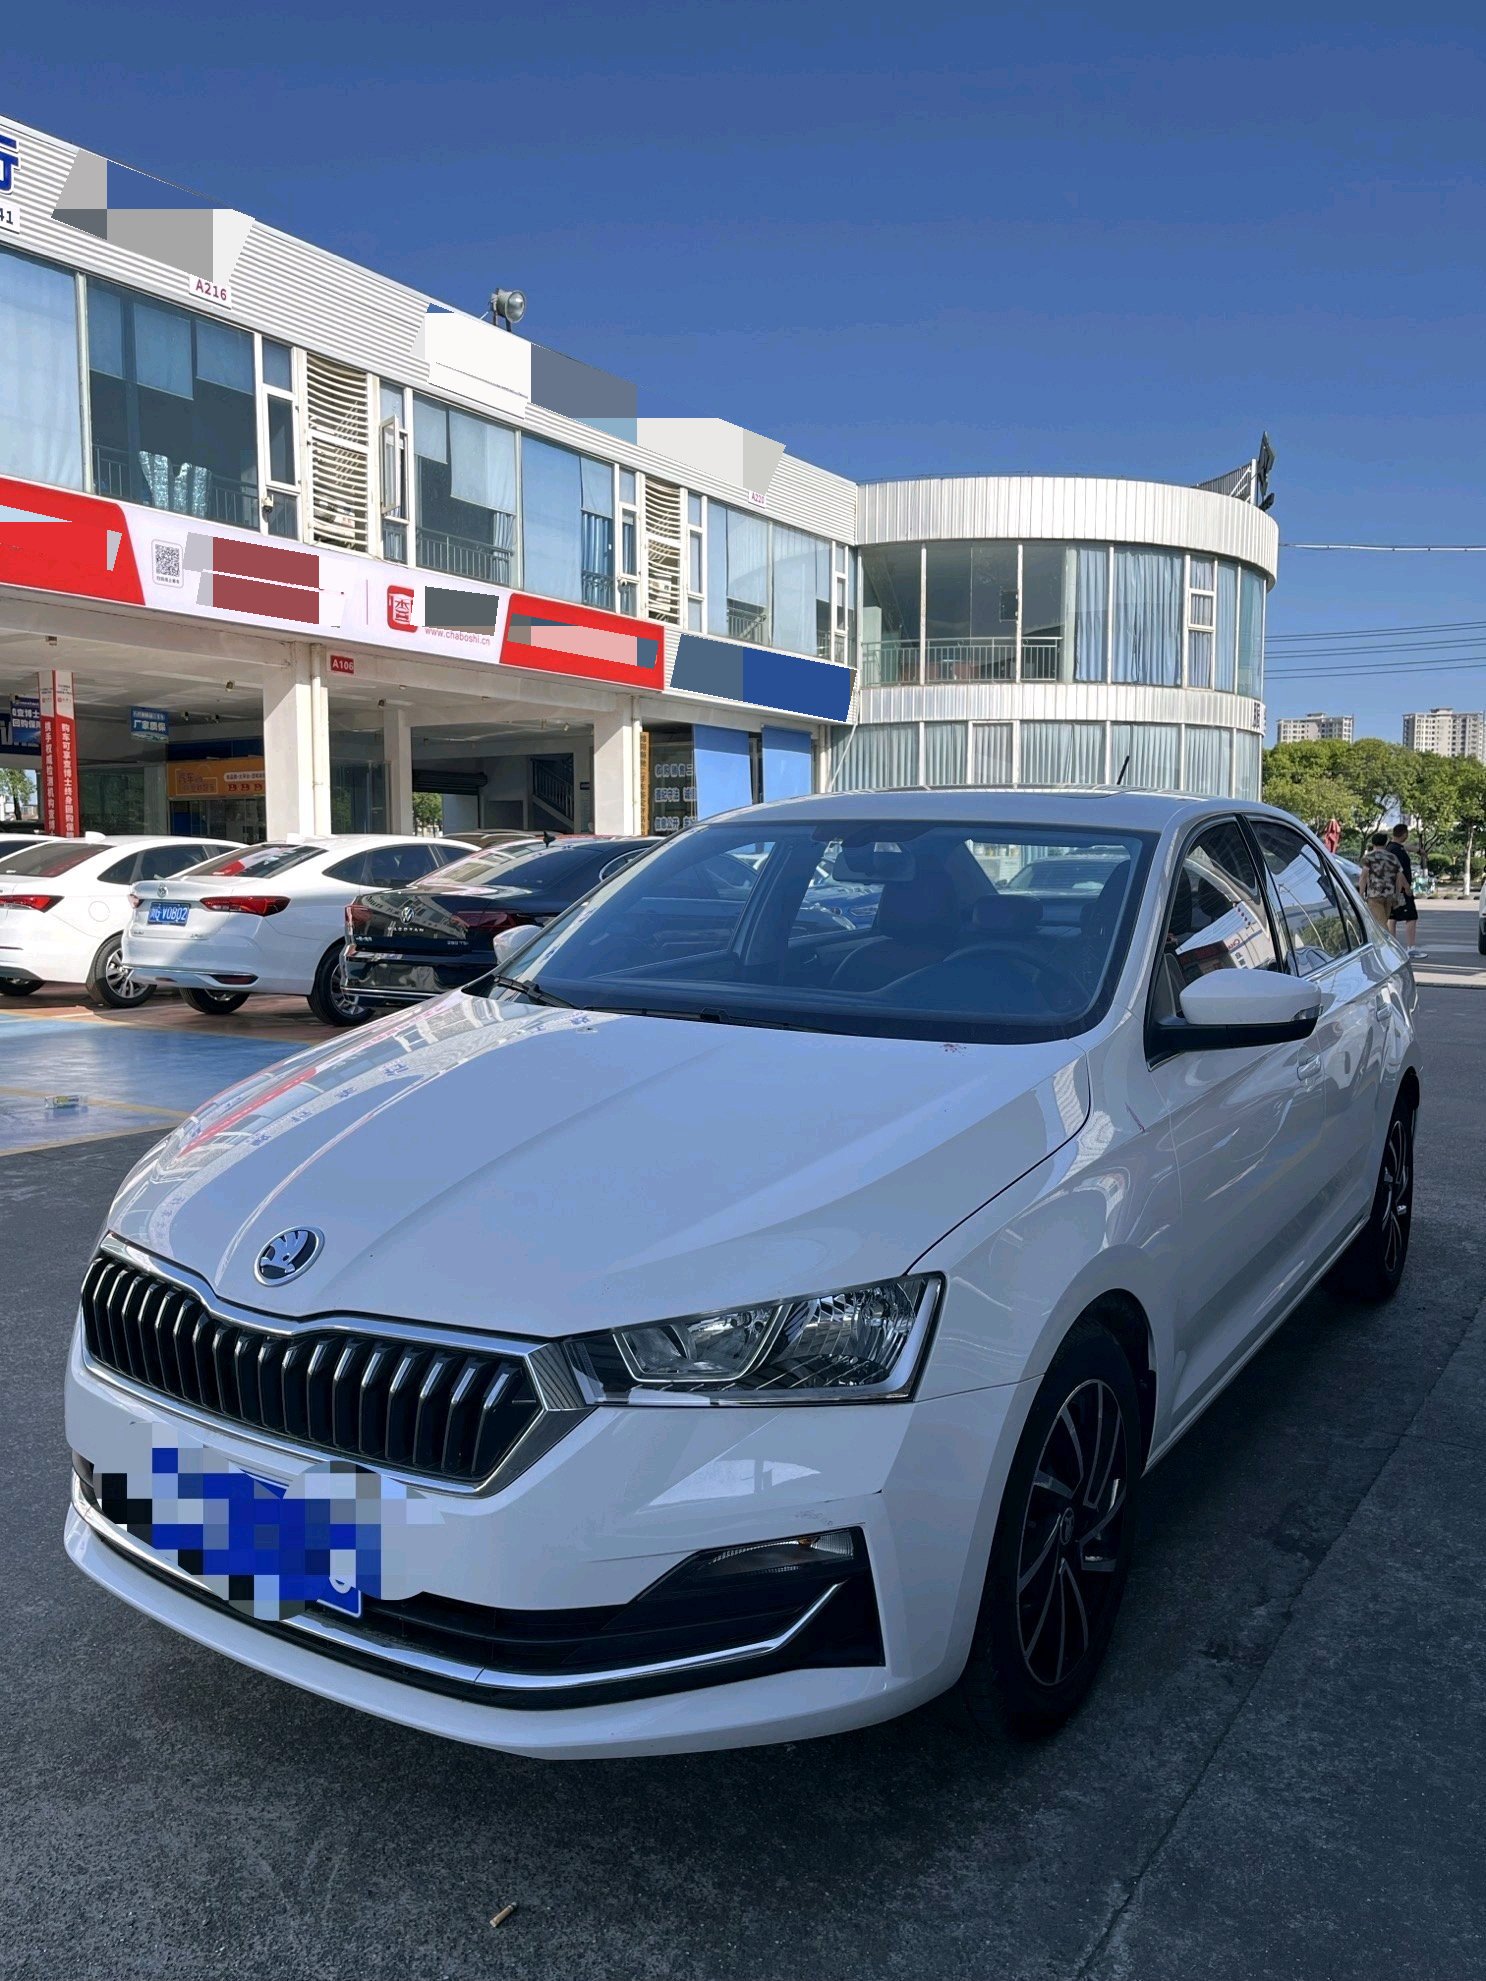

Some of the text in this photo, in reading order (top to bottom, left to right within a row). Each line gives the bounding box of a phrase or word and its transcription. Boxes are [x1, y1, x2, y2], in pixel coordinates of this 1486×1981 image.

[195, 279, 227, 301] A216
[424, 626, 491, 646] www.chaboshi.cn
[332, 658, 354, 671] A106
